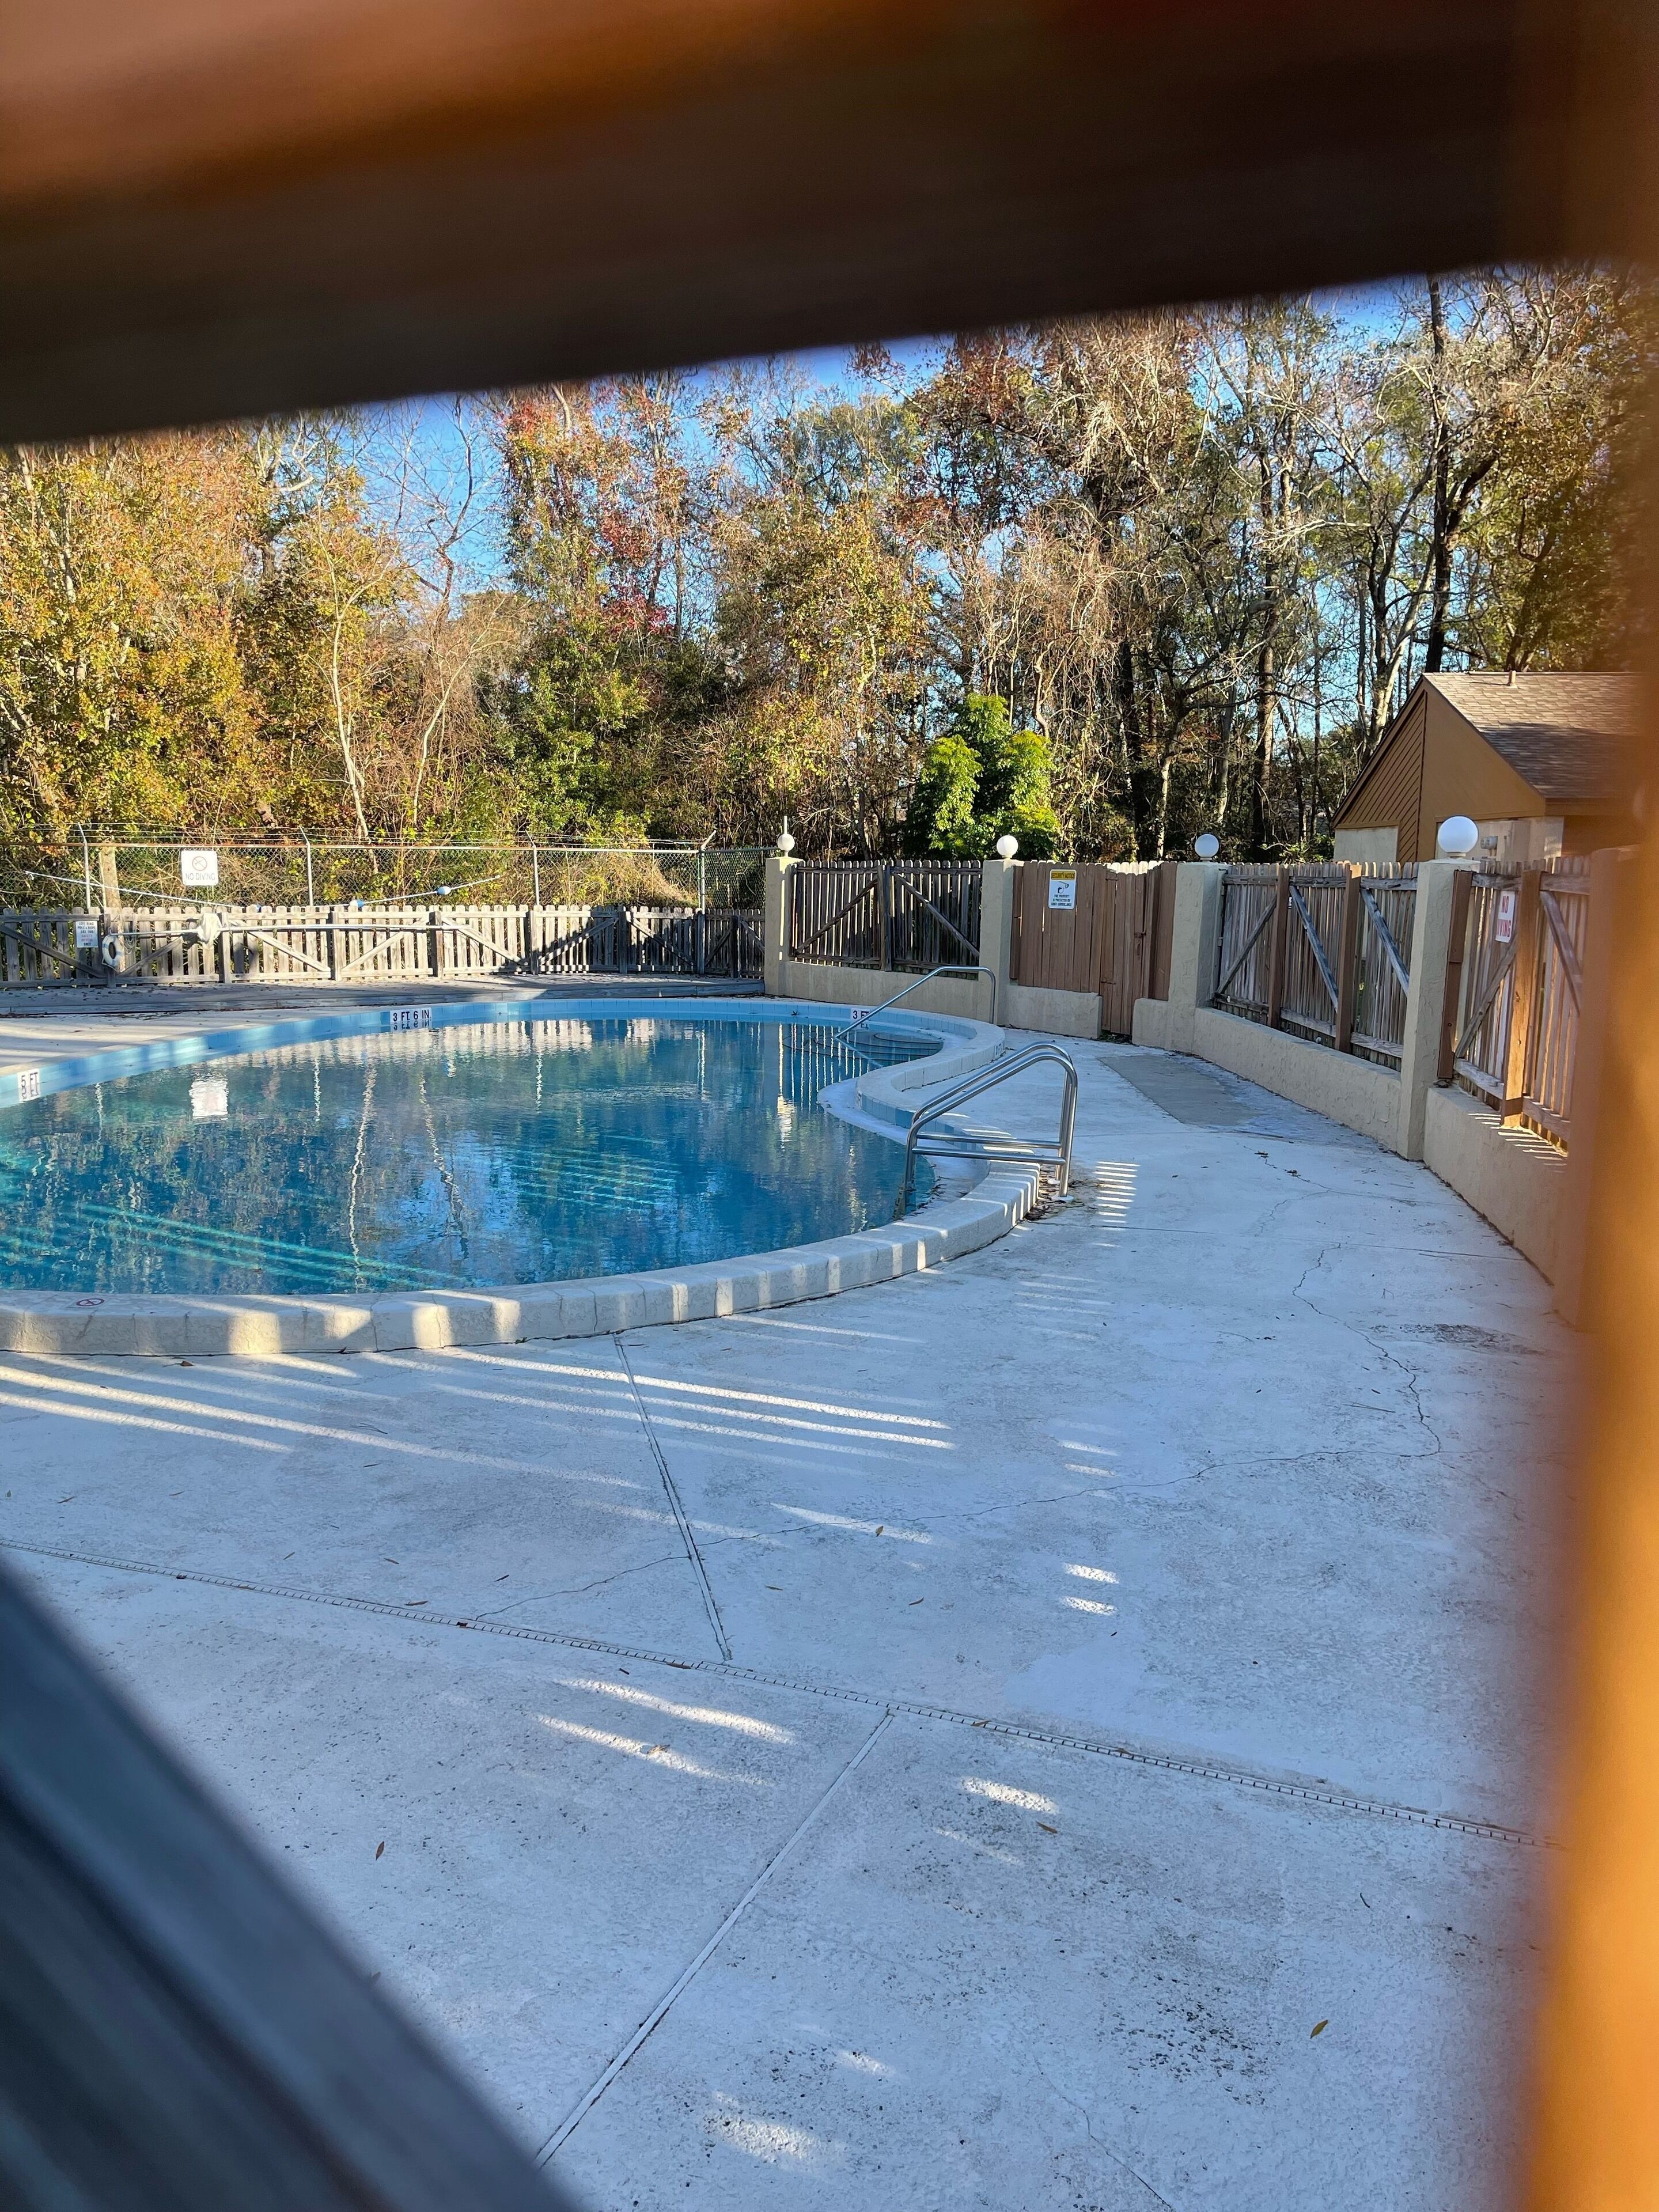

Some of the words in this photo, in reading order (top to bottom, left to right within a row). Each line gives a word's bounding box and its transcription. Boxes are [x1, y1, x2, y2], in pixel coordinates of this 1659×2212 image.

[185, 872, 194, 881] NO
[195, 872, 215, 881] DIVING
[1501, 895, 1510, 914] NO
[1497, 919, 1511, 937] IVING
[393, 1012, 398, 1022] 3
[413, 1010, 419, 1020] 6
[853, 1010, 858, 1020] 3
[21, 1075, 26, 1088] 5
[29, 1072, 38, 1086] FT
